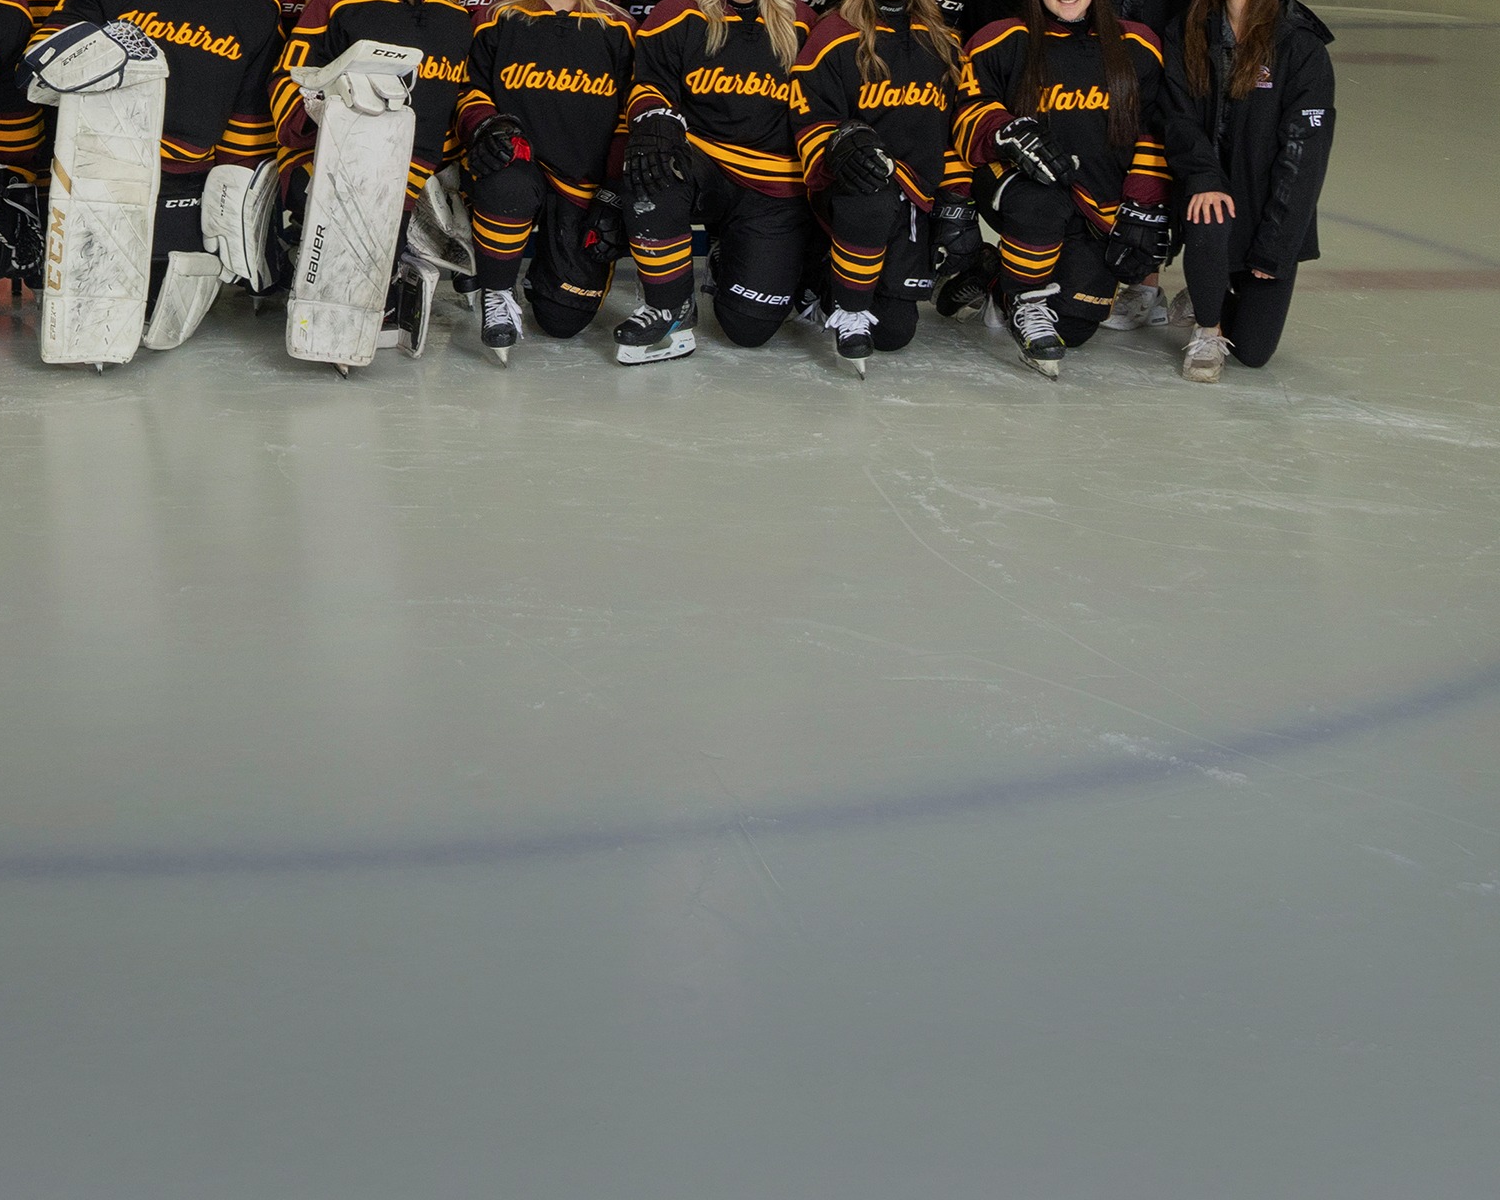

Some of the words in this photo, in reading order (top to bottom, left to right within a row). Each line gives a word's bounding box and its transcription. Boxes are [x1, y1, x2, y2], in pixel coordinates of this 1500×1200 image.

[117, 9, 244, 62] Warbirds
[372, 49, 408, 60] CCM
[500, 61, 618, 97] Warbirds
[685, 65, 791, 102] Warbird
[789, 78, 811, 116] 4
[1308, 115, 1322, 127] 15
[1121, 205, 1169, 225] TRUE
[47, 206, 67, 291] CCM
[306, 224, 326, 285] BAUER
[729, 283, 791, 307] BAUER
